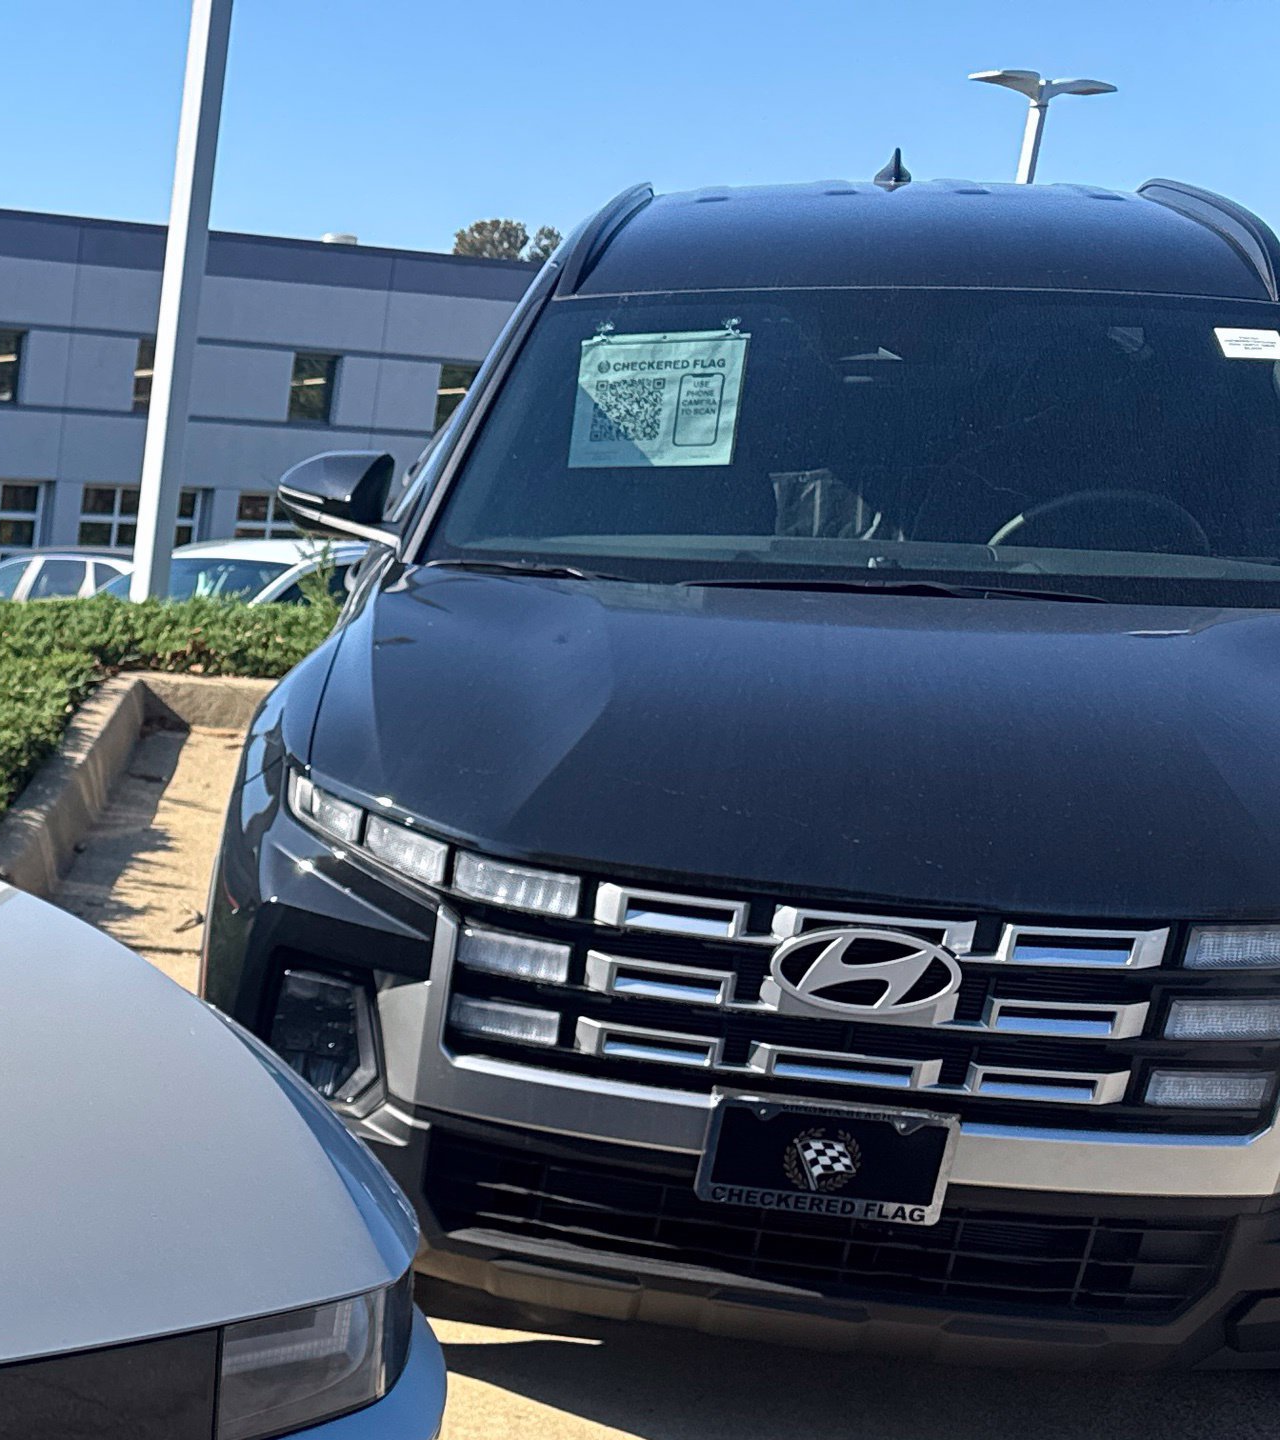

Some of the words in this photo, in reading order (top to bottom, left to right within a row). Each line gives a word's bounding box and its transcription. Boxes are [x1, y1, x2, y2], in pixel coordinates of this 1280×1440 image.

[613, 360, 690, 371] CHECKERED
[692, 358, 726, 369] FLAG
[693, 380, 711, 388] USE
[686, 389, 714, 397] PHONE
[681, 398, 717, 406] CAMERA
[681, 407, 692, 415] TO
[693, 407, 716, 415] SCAN
[711, 1186, 856, 1215] CHECKERED
[863, 1202, 926, 1223] FLAG
